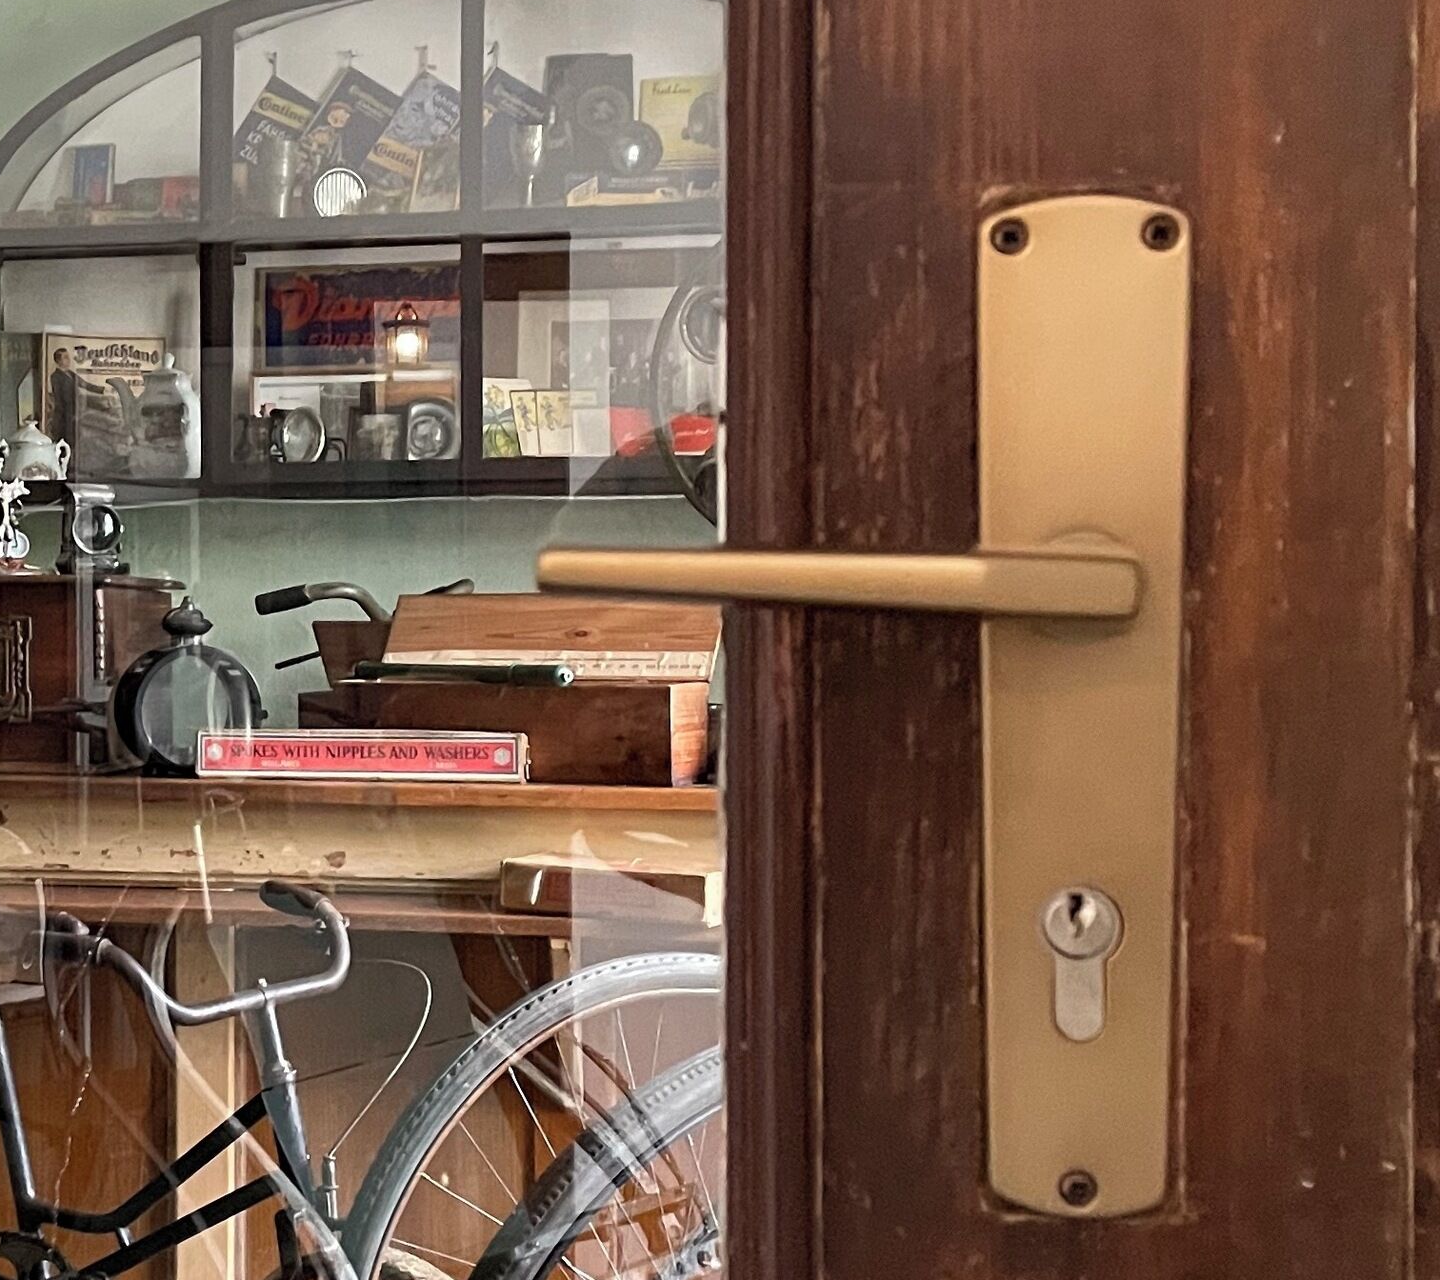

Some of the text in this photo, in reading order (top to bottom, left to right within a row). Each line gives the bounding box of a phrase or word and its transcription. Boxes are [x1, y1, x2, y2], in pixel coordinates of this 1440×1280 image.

[257, 97, 311, 126] Contine
[282, 744, 320, 759] WITH
[325, 745, 387, 760] NIPPLES
[389, 746, 418, 760] AND
[423, 746, 490, 761] WASHERS
